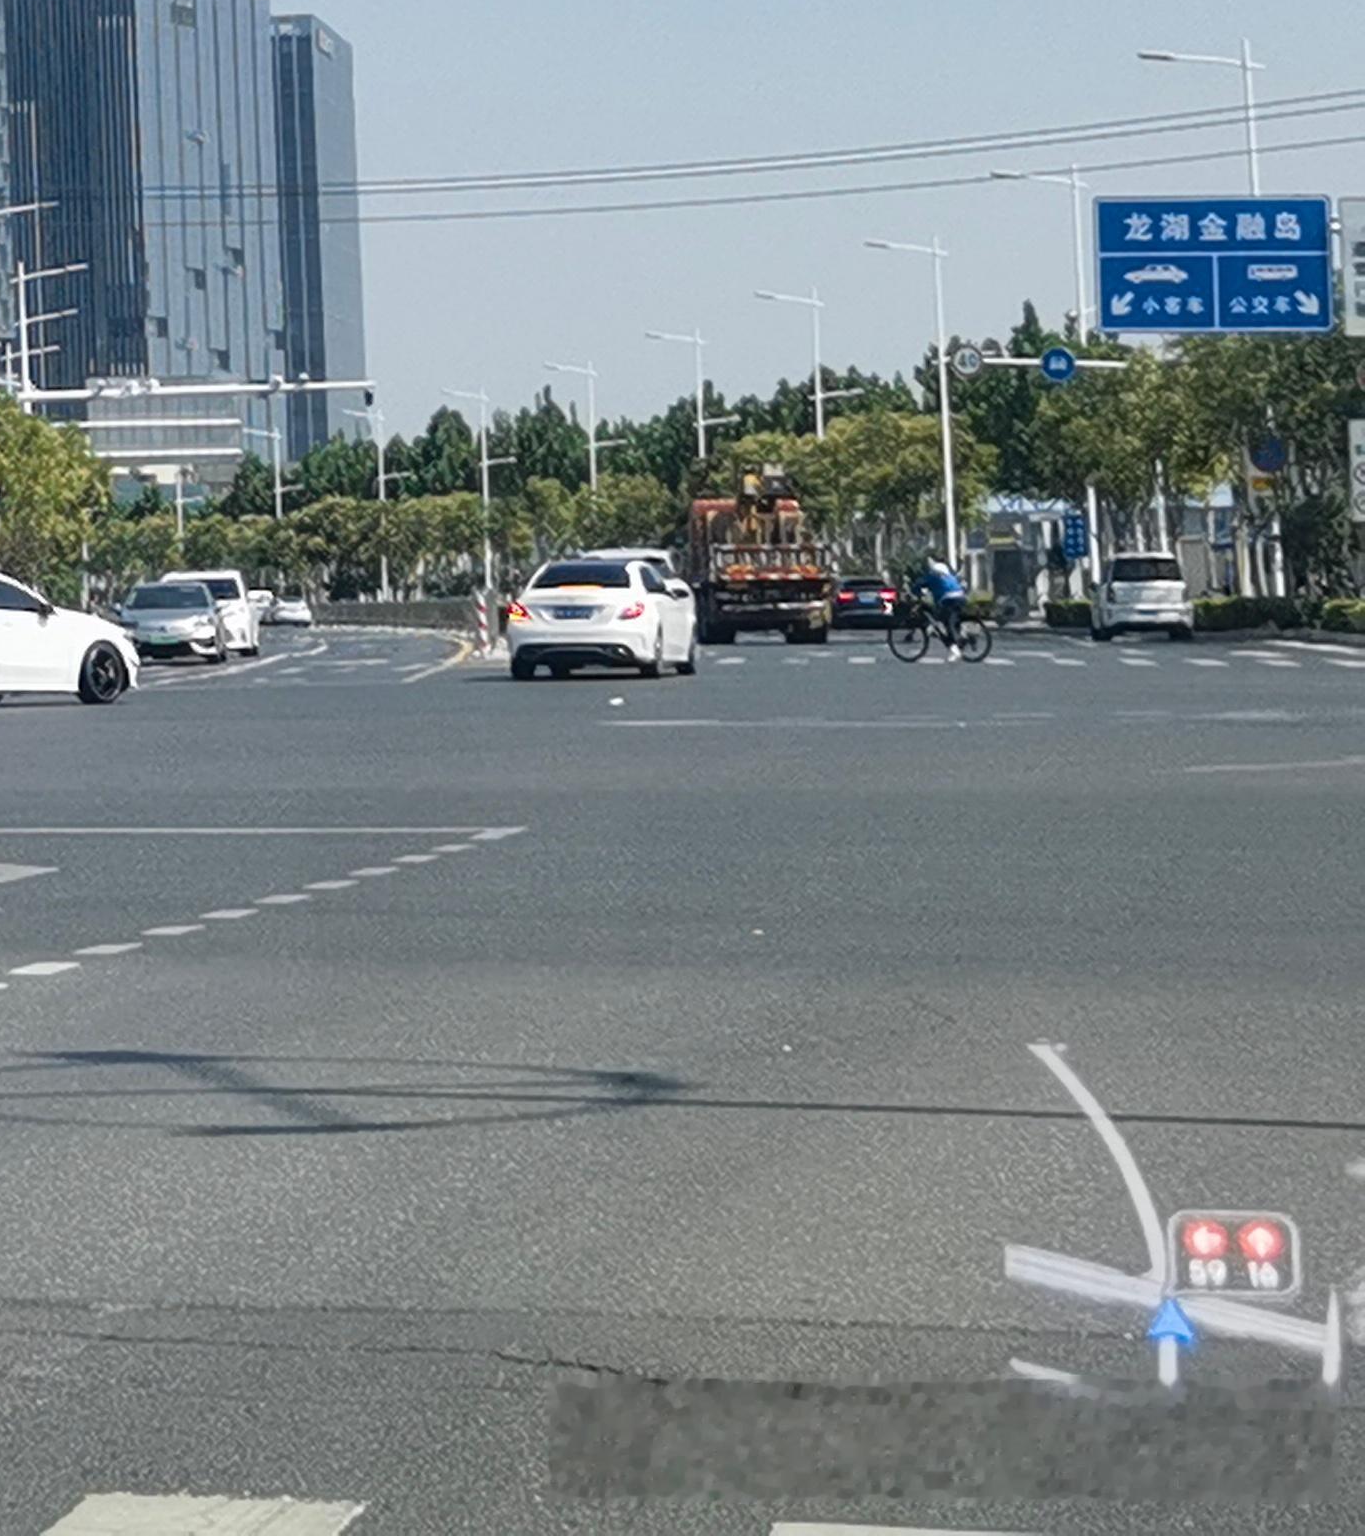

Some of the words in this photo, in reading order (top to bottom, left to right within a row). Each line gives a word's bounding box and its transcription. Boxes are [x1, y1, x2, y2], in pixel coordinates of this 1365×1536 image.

[1123, 212, 1301, 241] 龙湖金融岛
[1142, 295, 1205, 315] 小客车
[1229, 295, 1291, 315] 公交车
